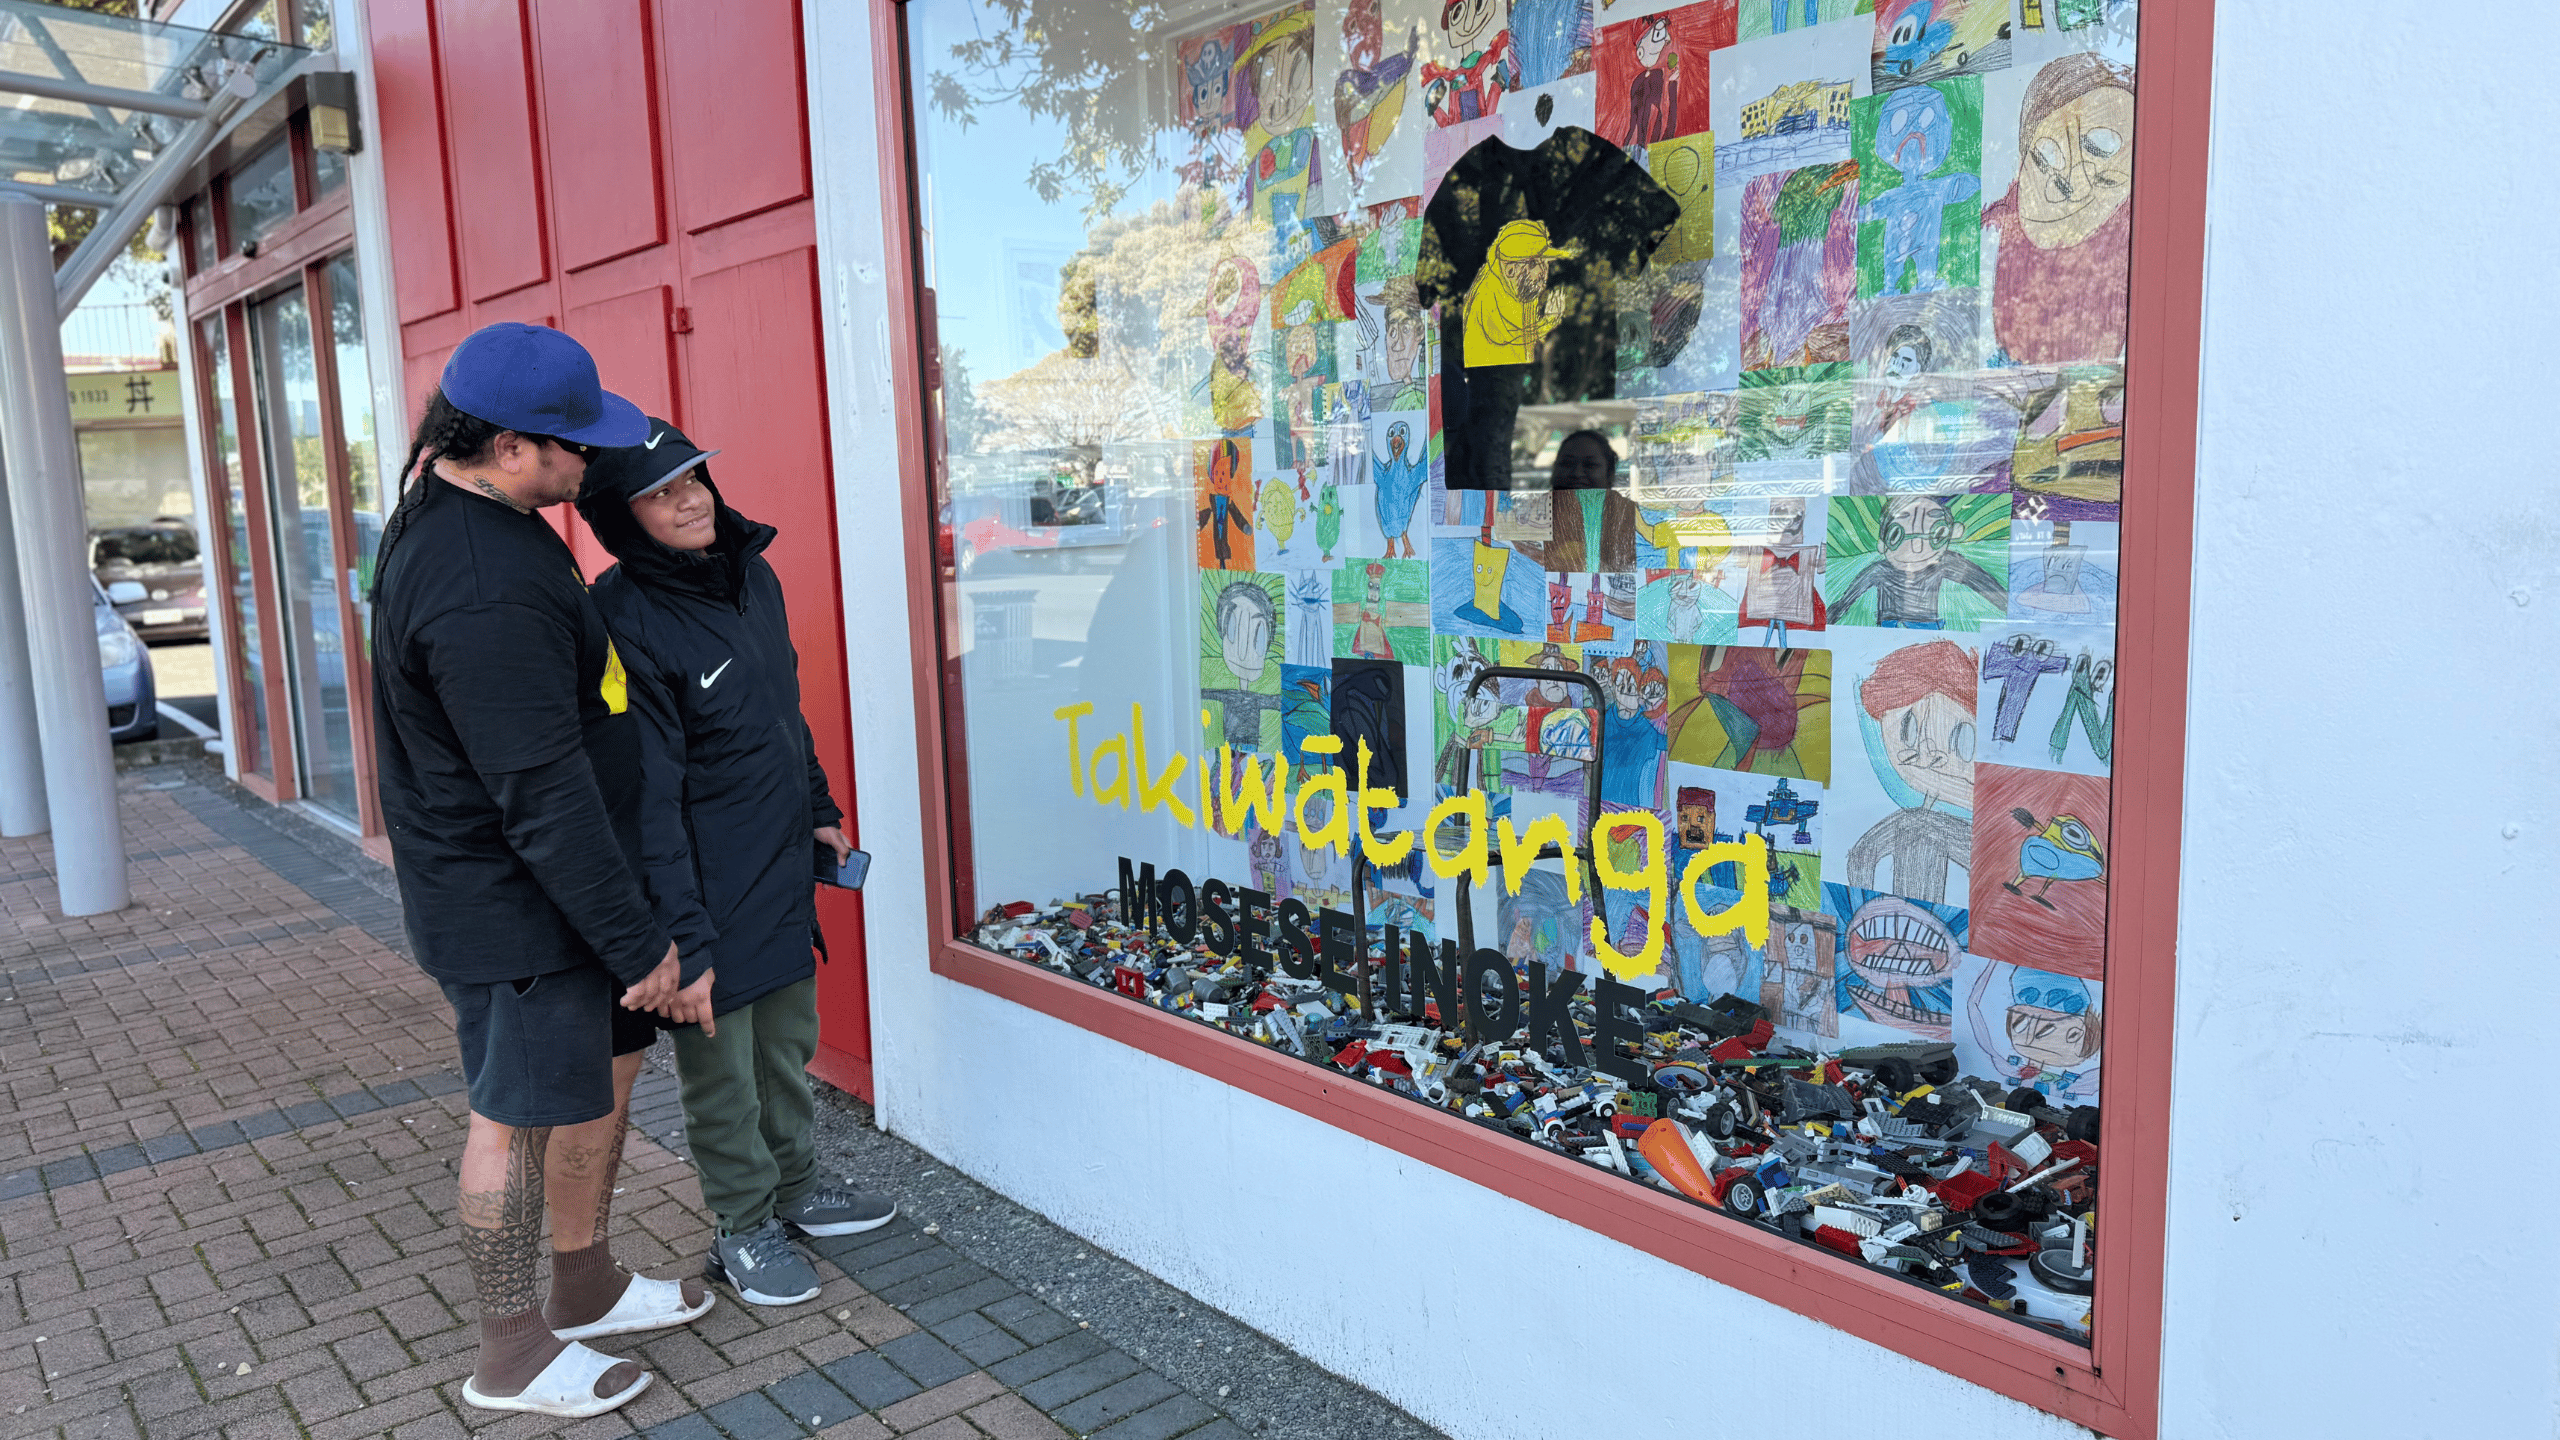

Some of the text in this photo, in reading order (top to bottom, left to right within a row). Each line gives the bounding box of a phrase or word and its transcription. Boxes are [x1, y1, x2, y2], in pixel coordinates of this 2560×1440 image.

[1054, 701, 1769, 979] Takiwātanga
[1117, 855, 1648, 1087] MOSESE INOKE
[737, 1247, 756, 1271] PUMA
